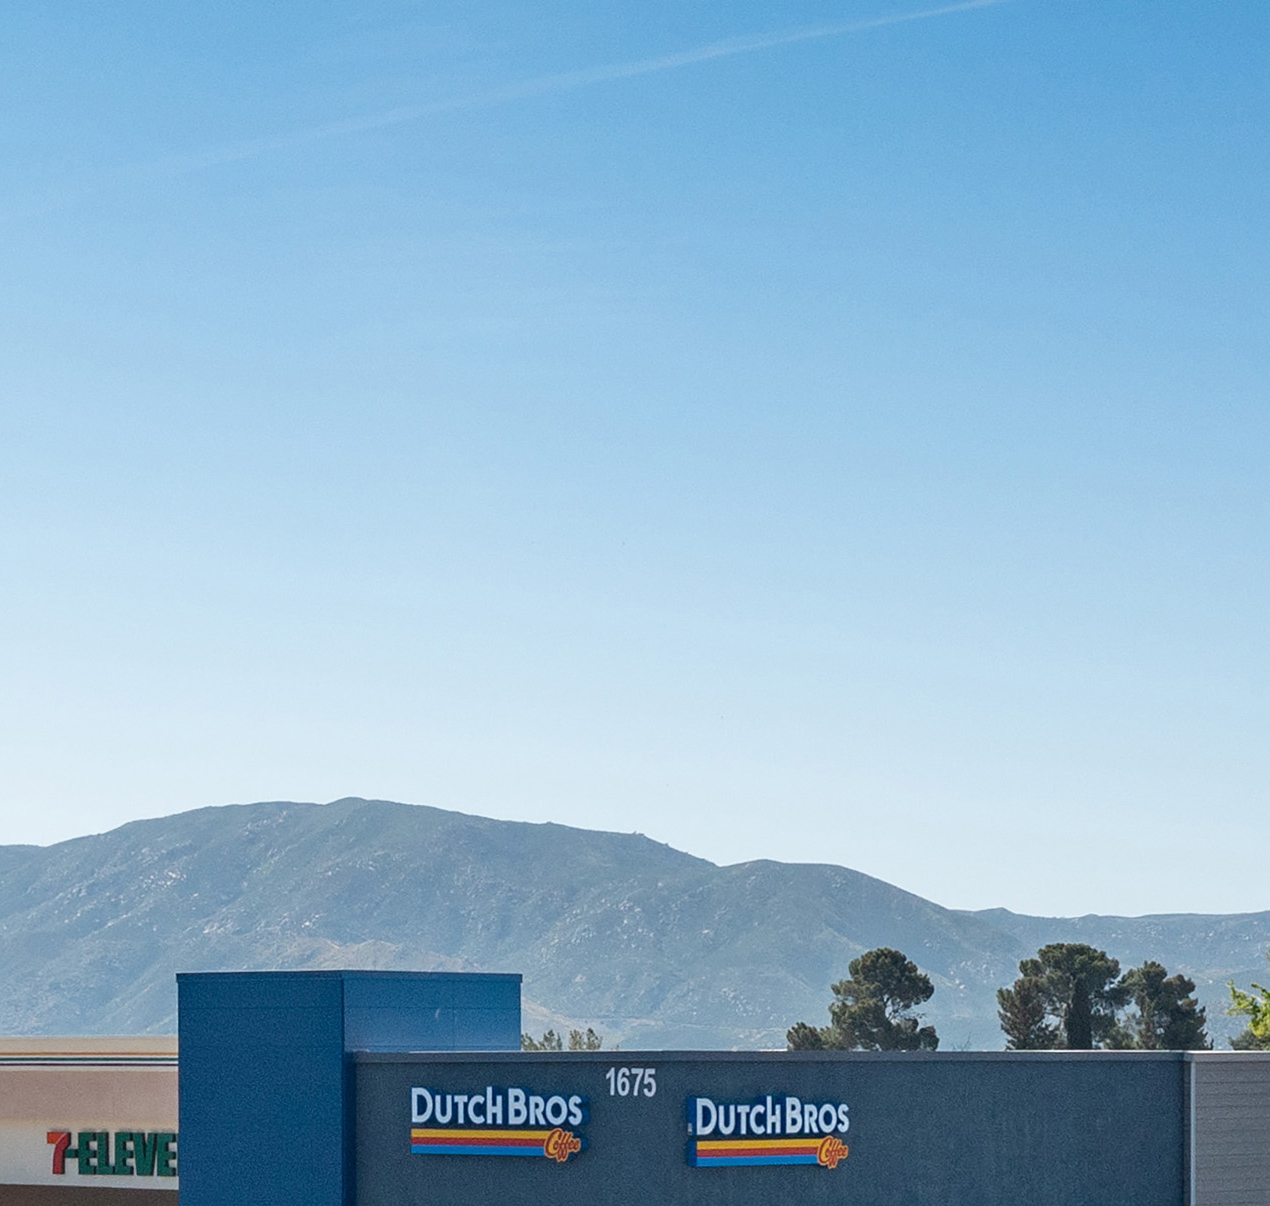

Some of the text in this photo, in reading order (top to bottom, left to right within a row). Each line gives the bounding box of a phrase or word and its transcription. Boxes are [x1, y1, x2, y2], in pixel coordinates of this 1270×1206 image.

[606, 1067, 656, 1097] 1675
[47, 1132, 179, 1177] 7-ELEVE
[545, 1129, 579, 1161] Coffee
[819, 1137, 848, 1168] Coffee
